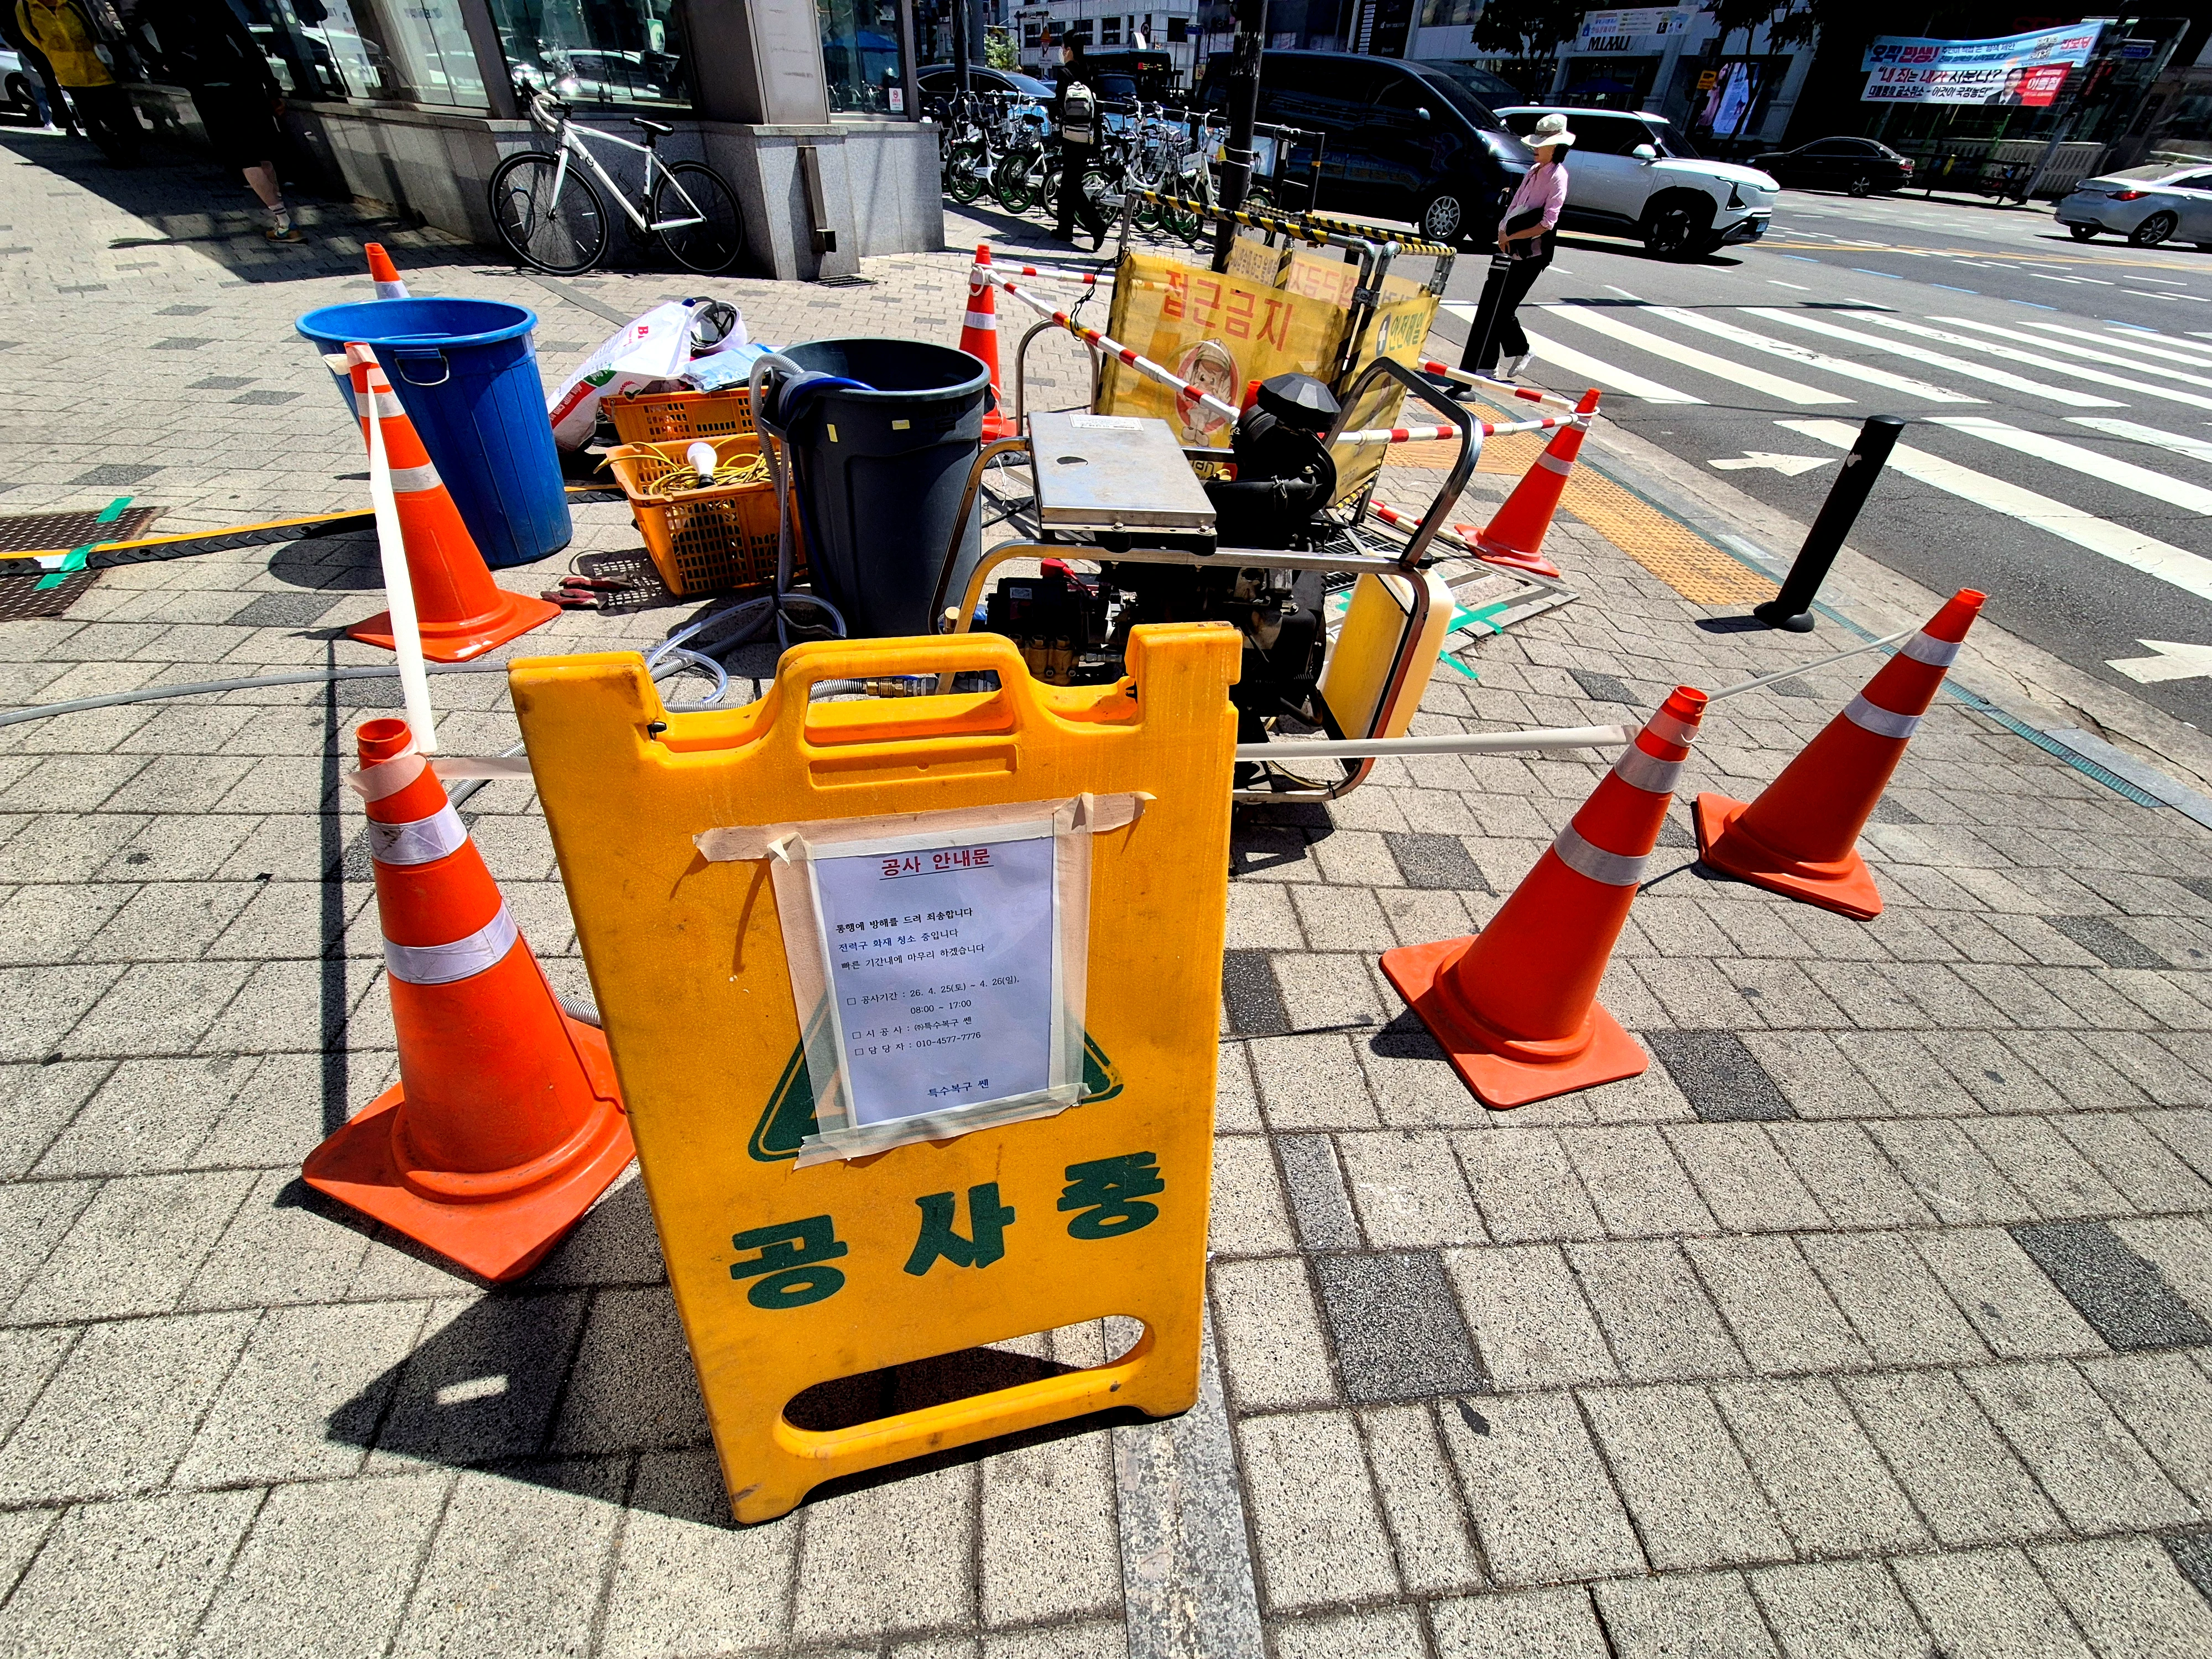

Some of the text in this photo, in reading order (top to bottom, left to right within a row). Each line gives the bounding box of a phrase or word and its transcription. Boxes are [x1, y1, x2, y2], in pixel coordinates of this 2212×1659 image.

[1870, 45, 1902, 63] 오직
[1895, 69, 1918, 83] 죄는
[1896, 85, 1924, 97] 공소취소
[1932, 86, 1955, 97] 이것이
[1162, 269, 1293, 352] 접근금지
[1389, 311, 1426, 351] 안전제일
[881, 848, 990, 877] 공사 안내문
[836, 907, 973, 934] 통행에 방해를 드려 죄송합니다
[838, 928, 959, 953] 전력구 화재 청소 중입니다
[841, 943, 985, 971] 빠른 기간내에 마무리 하겠습니다
[860, 992, 898, 1005] 공사기간
[910, 989, 924, 998] 26.
[941, 982, 966, 994] 25(토)
[979, 980, 988, 988] 4.
[910, 1004, 935, 1015] 08:00
[948, 999, 972, 1010] 17:00
[916, 1031, 981, 1048] 010-4577-7776
[927, 1082, 973, 1098] 특수복구
